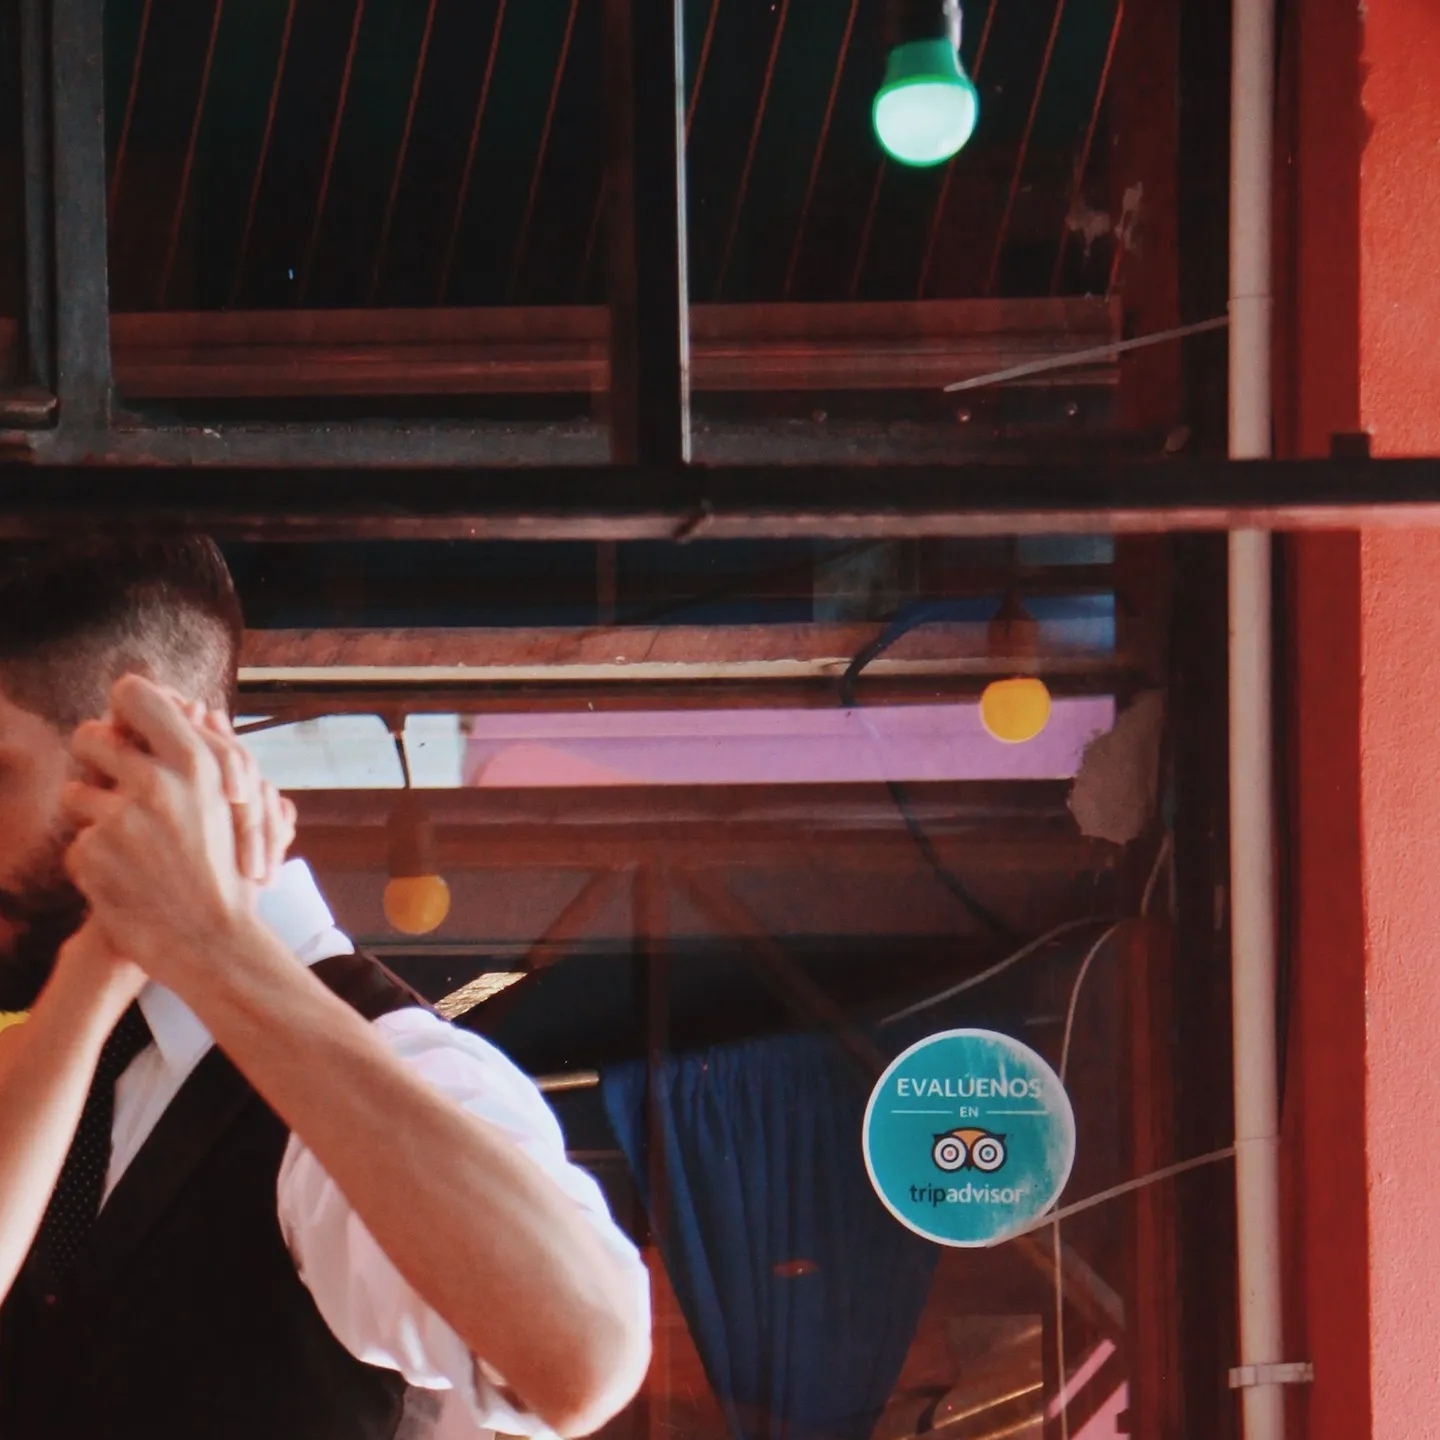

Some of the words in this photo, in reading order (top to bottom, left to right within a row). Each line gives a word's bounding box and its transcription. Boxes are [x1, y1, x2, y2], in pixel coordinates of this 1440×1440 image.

[896, 1073, 1043, 1098] EVALÚENOS
[959, 1106, 979, 1118] EN
[909, 1183, 1024, 1207] tripadvisor
